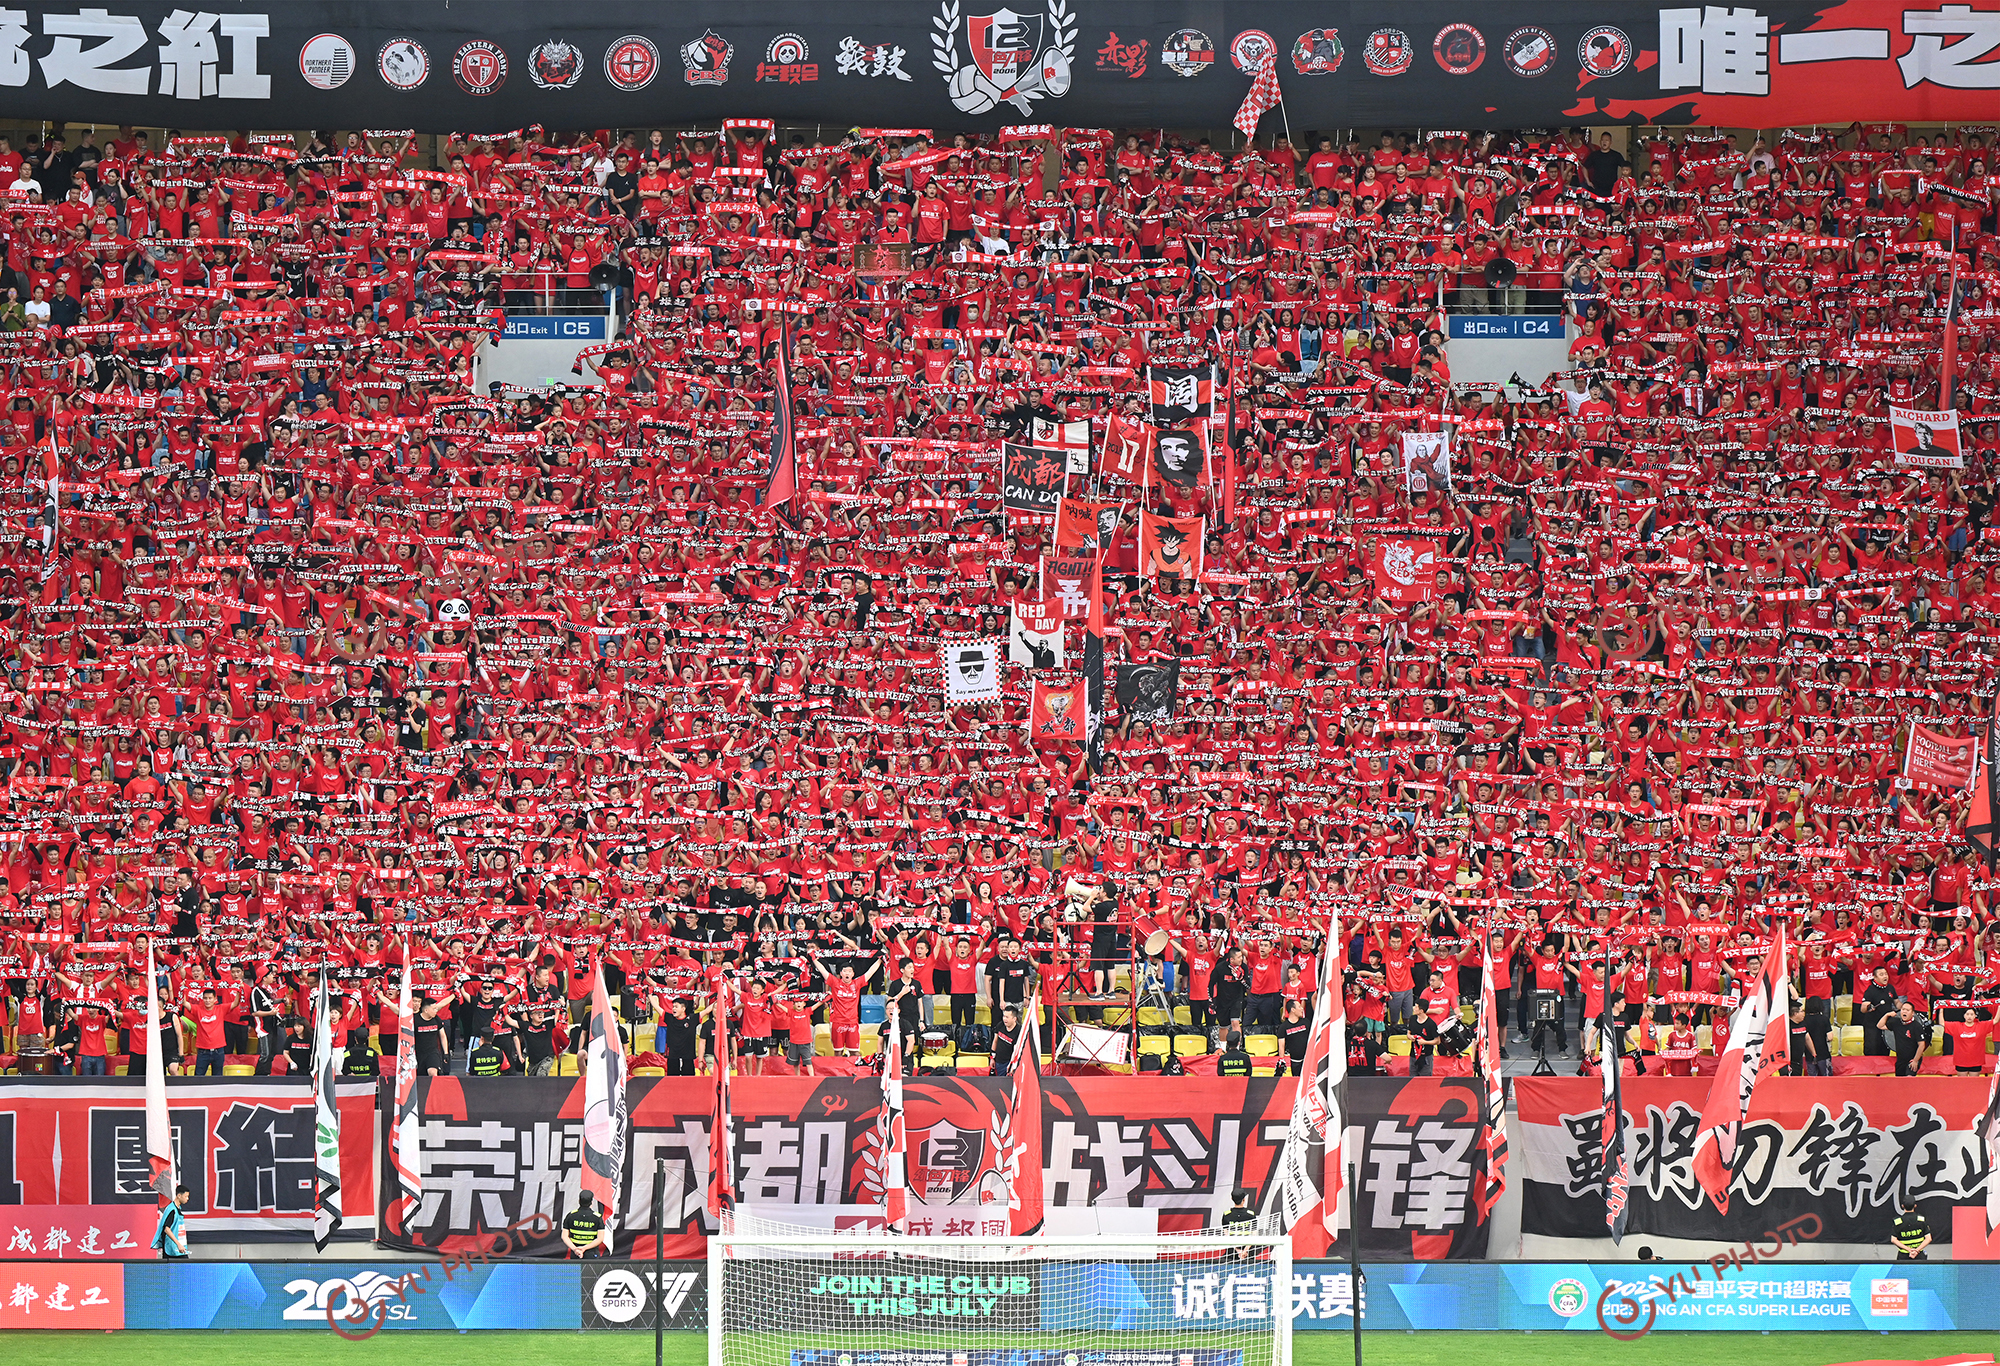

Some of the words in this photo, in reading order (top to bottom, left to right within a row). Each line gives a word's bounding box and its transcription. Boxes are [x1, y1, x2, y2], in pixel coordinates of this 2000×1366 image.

[1434, 24, 1455, 46] SOUTHERN
[1472, 29, 1485, 47] GUARD
[456, 41, 492, 58] EASTERN
[494, 48, 508, 76] FRONT
[980, 49, 1033, 66] 红色刀锋
[1659, 5, 2000, 96] 唯一之
[687, 70, 727, 82] CBS
[471, 86, 491, 94] 2023
[504, 322, 529, 335] 出口
[530, 327, 548, 335] Exit
[563, 322, 590, 335] C5
[1464, 322, 1488, 334] 出口
[1490, 326, 1508, 334] Exit
[1523, 320, 1550, 334] C4
[1895, 410, 1950, 421] RICHARD
[1117, 433, 1139, 473] 17
[1903, 455, 1925, 464] YOU
[1927, 458, 1954, 466] CAN!
[1005, 448, 1065, 490] 成都
[1005, 485, 1033, 502] CAN
[1038, 489, 1061, 503] DO
[1047, 560, 1094, 577] FIGHT!!
[1390, 559, 1407, 569] CD
[1390, 568, 1415, 579] REDS
[1380, 587, 1402, 599] 成都
[1018, 603, 1046, 618] RED
[1034, 617, 1056, 630] DAY
[955, 688, 968, 696] Say
[1915, 735, 1952, 755] FOOTBALL
[1913, 755, 1935, 769] HERE
[1914, 745, 1936, 760] ELITE
[1938, 754, 1946, 763] IS
[90, 1103, 322, 1214] 團結
[412, 1118, 850, 1232] 荣耀成都
[913, 1169, 970, 1187] 红色刀锋
[7, 1225, 138, 1258] 成都建工
[603, 1281, 637, 1299] EA
[811, 1275, 882, 1295] JOIN
[887, 1275, 946, 1295] THE
[951, 1275, 1031, 1295] CLUB
[1605, 1274, 1668, 1302] 2023
[1671, 1280, 1852, 1299] 中国平安中超联赛
[0, 1282, 110, 1313] 都建工
[601, 1299, 638, 1309] SPORTS
[1172, 1273, 1367, 1320] 诚信联赛
[371, 1304, 418, 1320] CSL
[849, 1297, 918, 1316] THIS
[923, 1297, 998, 1316] JULY
[1642, 1304, 1677, 1316] PING
[1679, 1304, 1702, 1316] AN
[1706, 1304, 1736, 1316] CFA
[1738, 1304, 1789, 1316] SUPER
[1792, 1304, 1851, 1316] LEAGUE
